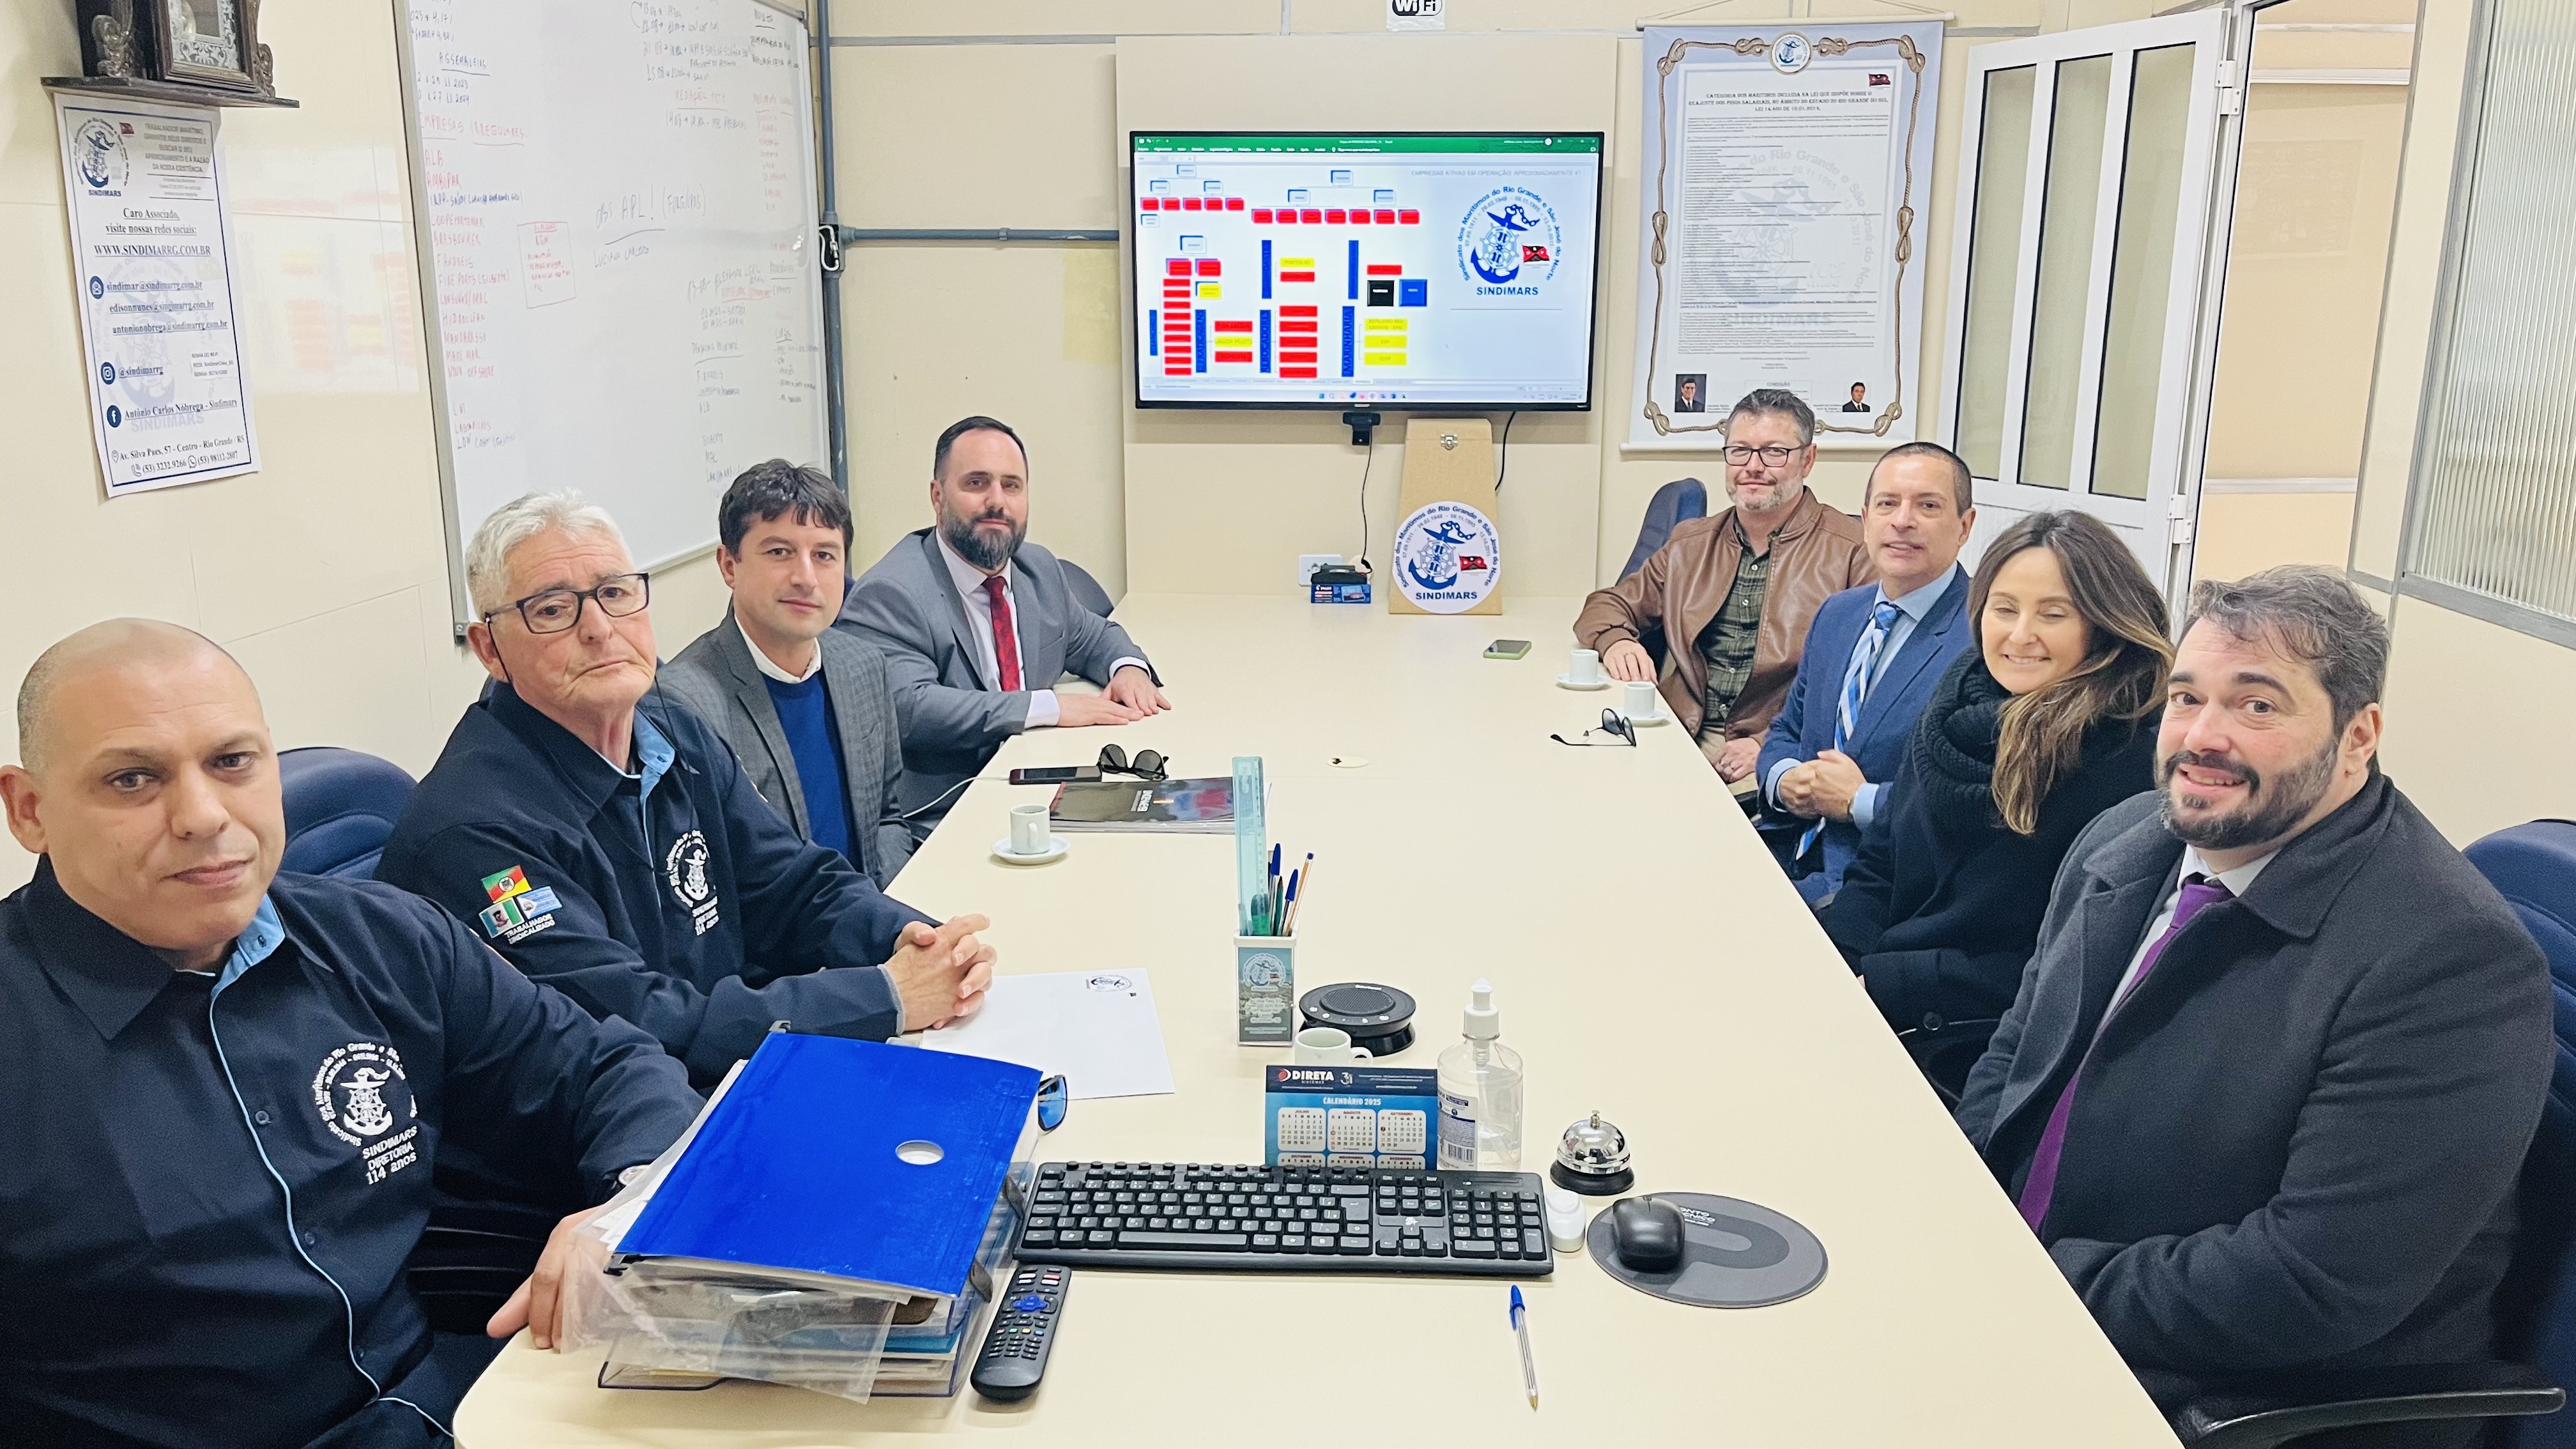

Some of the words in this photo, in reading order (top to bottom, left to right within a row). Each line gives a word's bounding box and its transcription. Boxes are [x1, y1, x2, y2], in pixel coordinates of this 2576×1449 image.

[1770, 149, 1791, 162] Rio
[1796, 150, 1841, 176] Grande
[1517, 187, 1542, 203] Grande
[123, 208, 143, 218] Caro
[1547, 208, 1556, 223] São
[105, 223, 126, 233] visite
[155, 224, 172, 234] redes
[173, 224, 197, 234] sociais:
[93, 245, 211, 256] WWW.SINDIMARRG.COM.BR
[1555, 247, 1561, 257] do
[1545, 259, 1560, 281] Norte
[1476, 287, 1539, 296] SINDIMARS
[1343, 310, 1352, 373] MARINHARIA
[118, 366, 164, 378] @sindimarrg
[152, 404, 174, 415] Carlos
[131, 450, 146, 459] Silva
[164, 445, 172, 454] 57
[177, 443, 198, 452] Centro
[214, 438, 233, 447] Grande
[237, 435, 245, 443] RS
[197, 456, 210, 466] (53)
[142, 464, 155, 474] (53)
[1452, 506, 1477, 519] Grande
[1482, 523, 1492, 537] São
[1492, 556, 1499, 565] do
[1484, 567, 1498, 586] Norte
[1415, 592, 1478, 600] SINDIMARS
[503, 913, 554, 939] TRABALHADOR
[348, 1042, 376, 1052] Grande
[331, 1048, 346, 1058] Rio
[1292, 1070, 1335, 1081] DIRETA
[1322, 1096, 1363, 1105] CALENDÁRIO
[1364, 1098, 1382, 1106] 2025
[328, 1121, 362, 1147] Sindicato
[362, 1126, 417, 1160] SINDIMARS
[367, 1141, 415, 1172] DIRETORIA
[365, 1167, 387, 1185] 114
[390, 1152, 417, 1173] anos
[1680, 1207, 1710, 1216] ONTO
